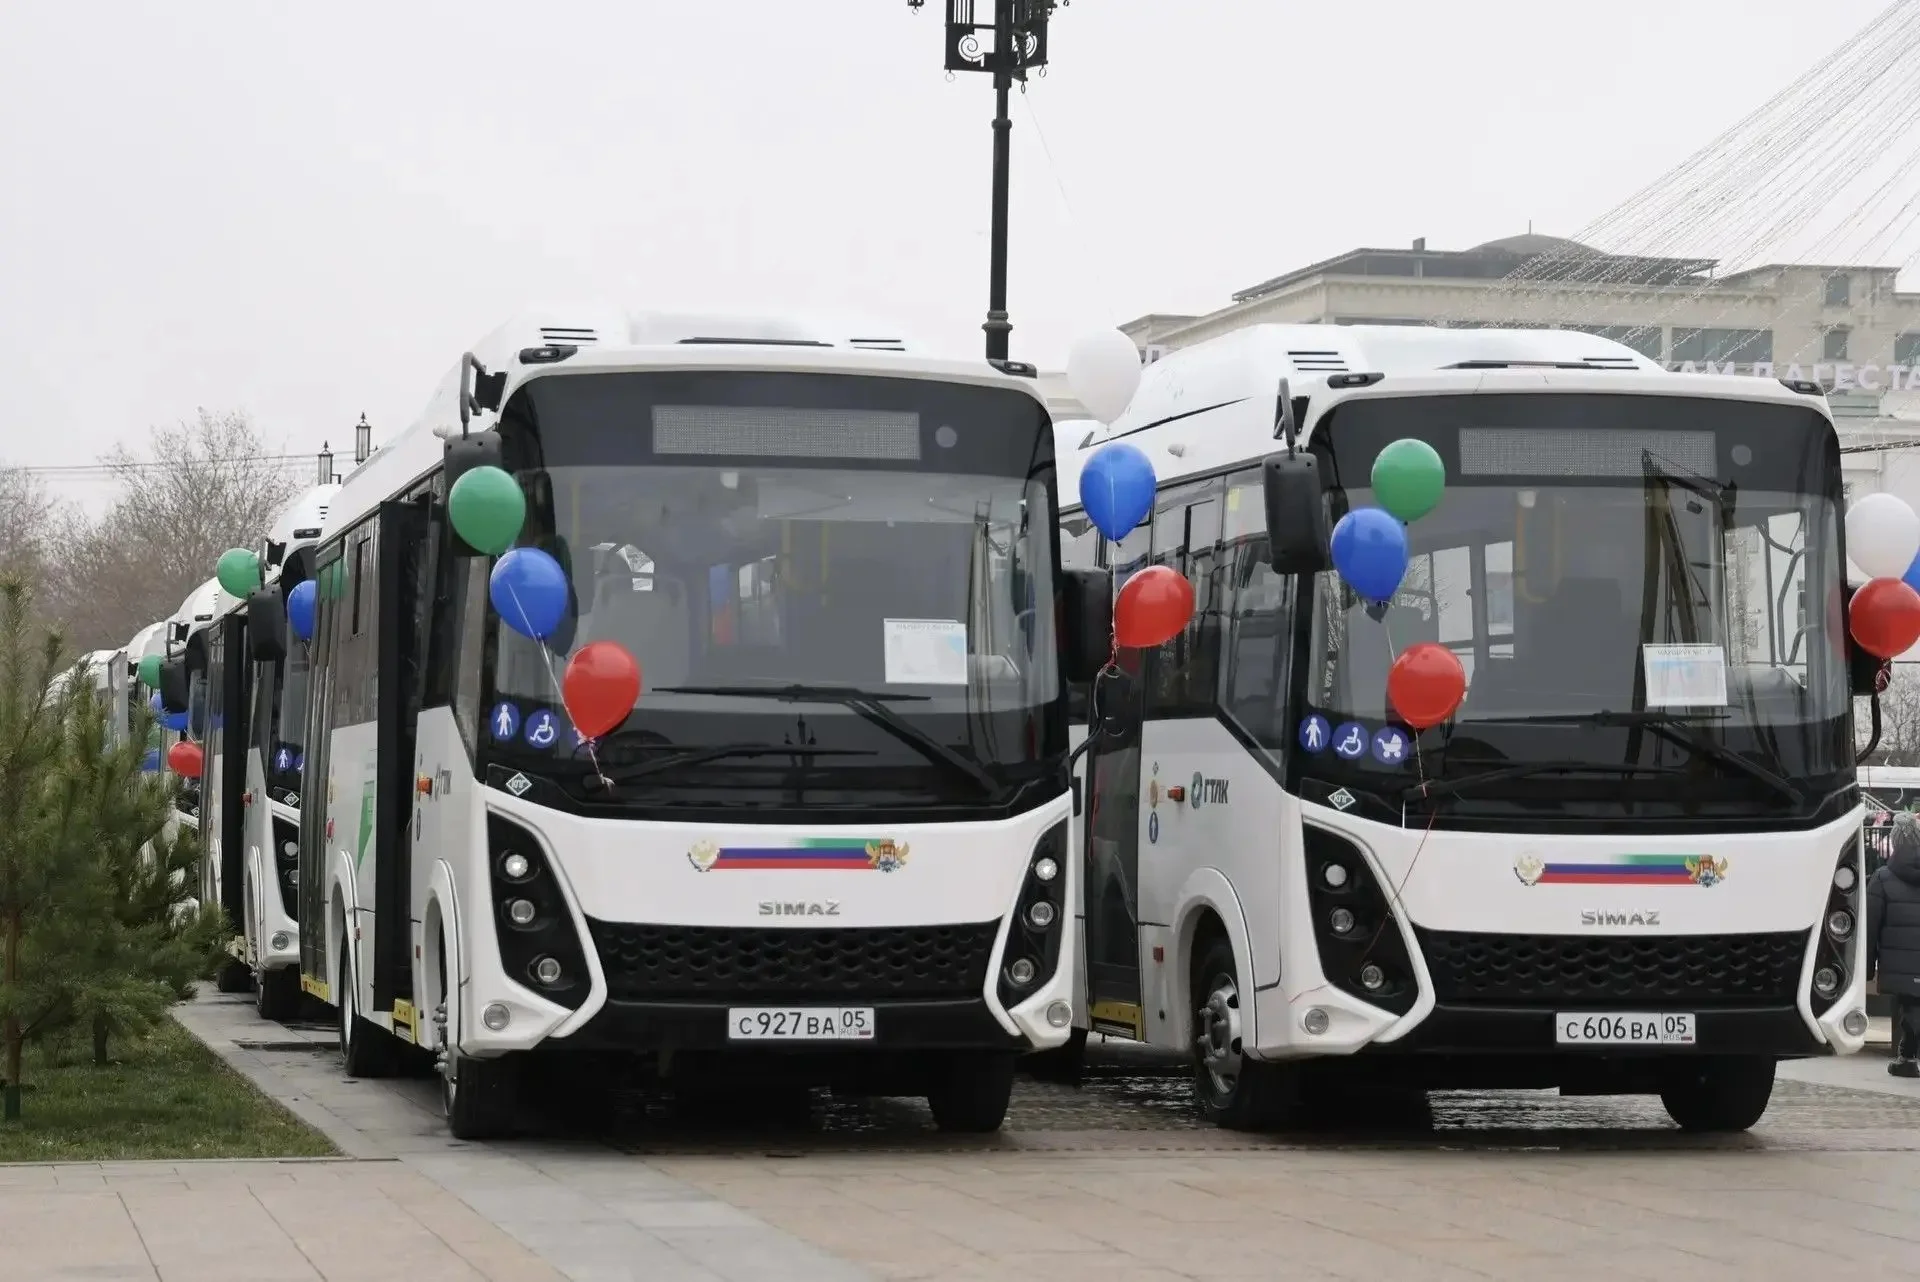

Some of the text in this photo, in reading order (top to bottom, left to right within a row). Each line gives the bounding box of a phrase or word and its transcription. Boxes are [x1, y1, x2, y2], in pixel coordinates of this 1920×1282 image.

[1204, 779, 1229, 804] ГТЛК
[758, 900, 840, 916] SIMAZ
[1581, 908, 1661, 925] SIMAZ
[842, 1011, 865, 1028] 05
[1665, 1016, 1687, 1034] 05
